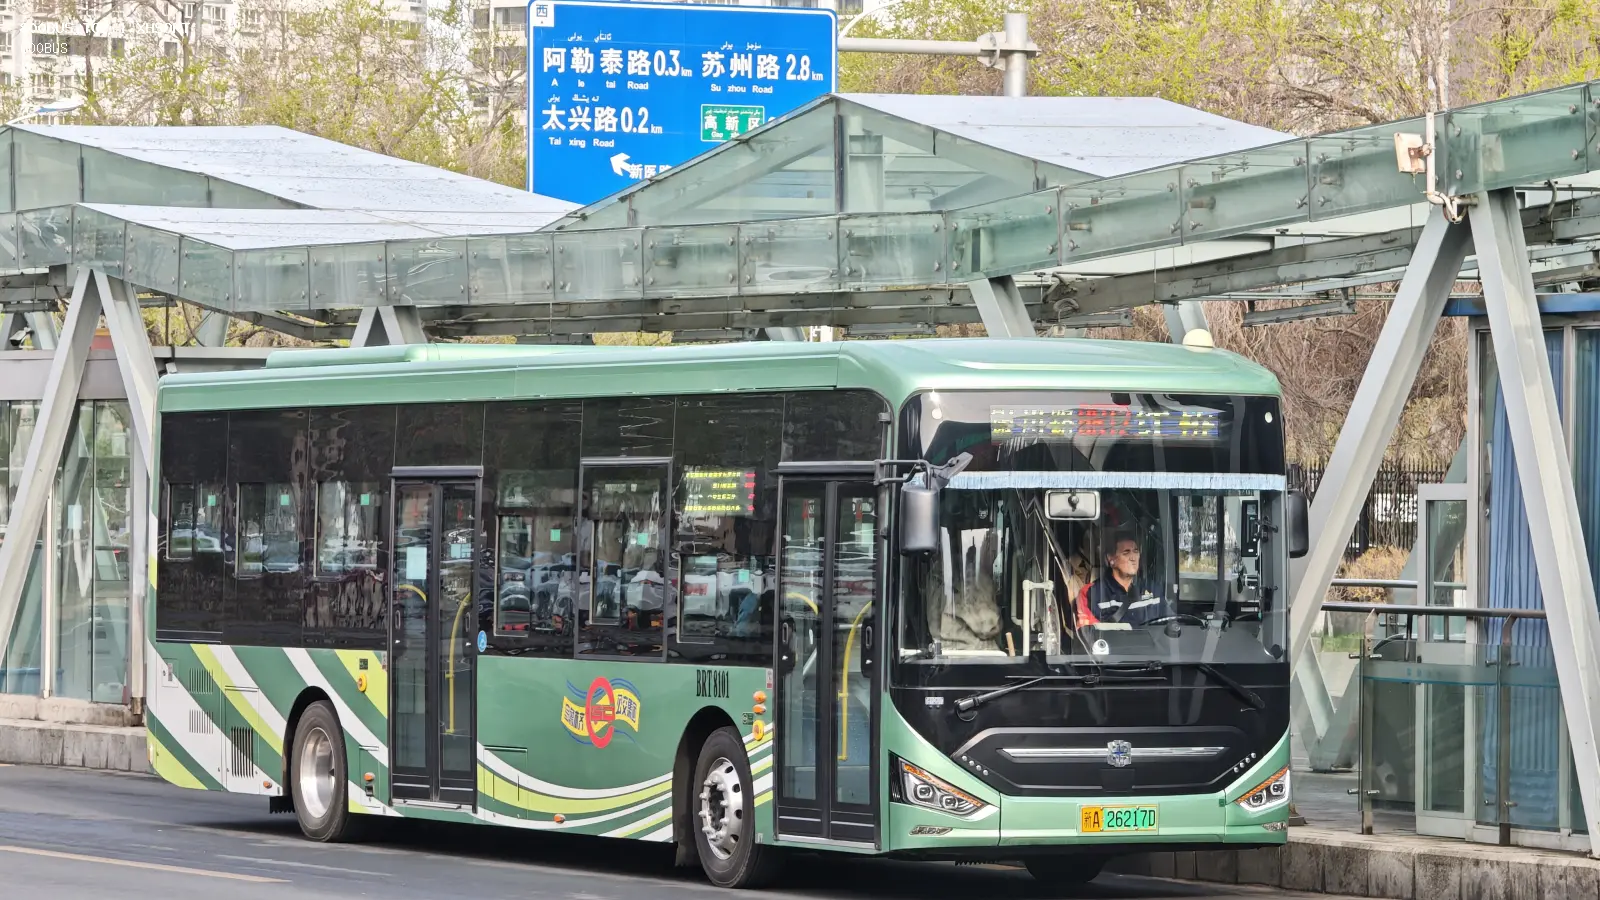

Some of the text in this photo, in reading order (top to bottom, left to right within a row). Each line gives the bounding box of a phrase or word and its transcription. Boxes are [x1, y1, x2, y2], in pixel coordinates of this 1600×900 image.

[536, 4, 548, 18] 西
[543, 47, 693, 77] 阿勒泰路 0.3 km
[701, 51, 824, 81] 苏州路 2.8 km
[551, 78, 649, 90] A le tai Road
[710, 83, 774, 94] Su zhou Road
[542, 104, 663, 134] 太兴路 0.2 km
[704, 115, 761, 131] 高新区
[548, 136, 615, 149] Tai xing Road
[696, 669, 730, 699] BRT 8101
